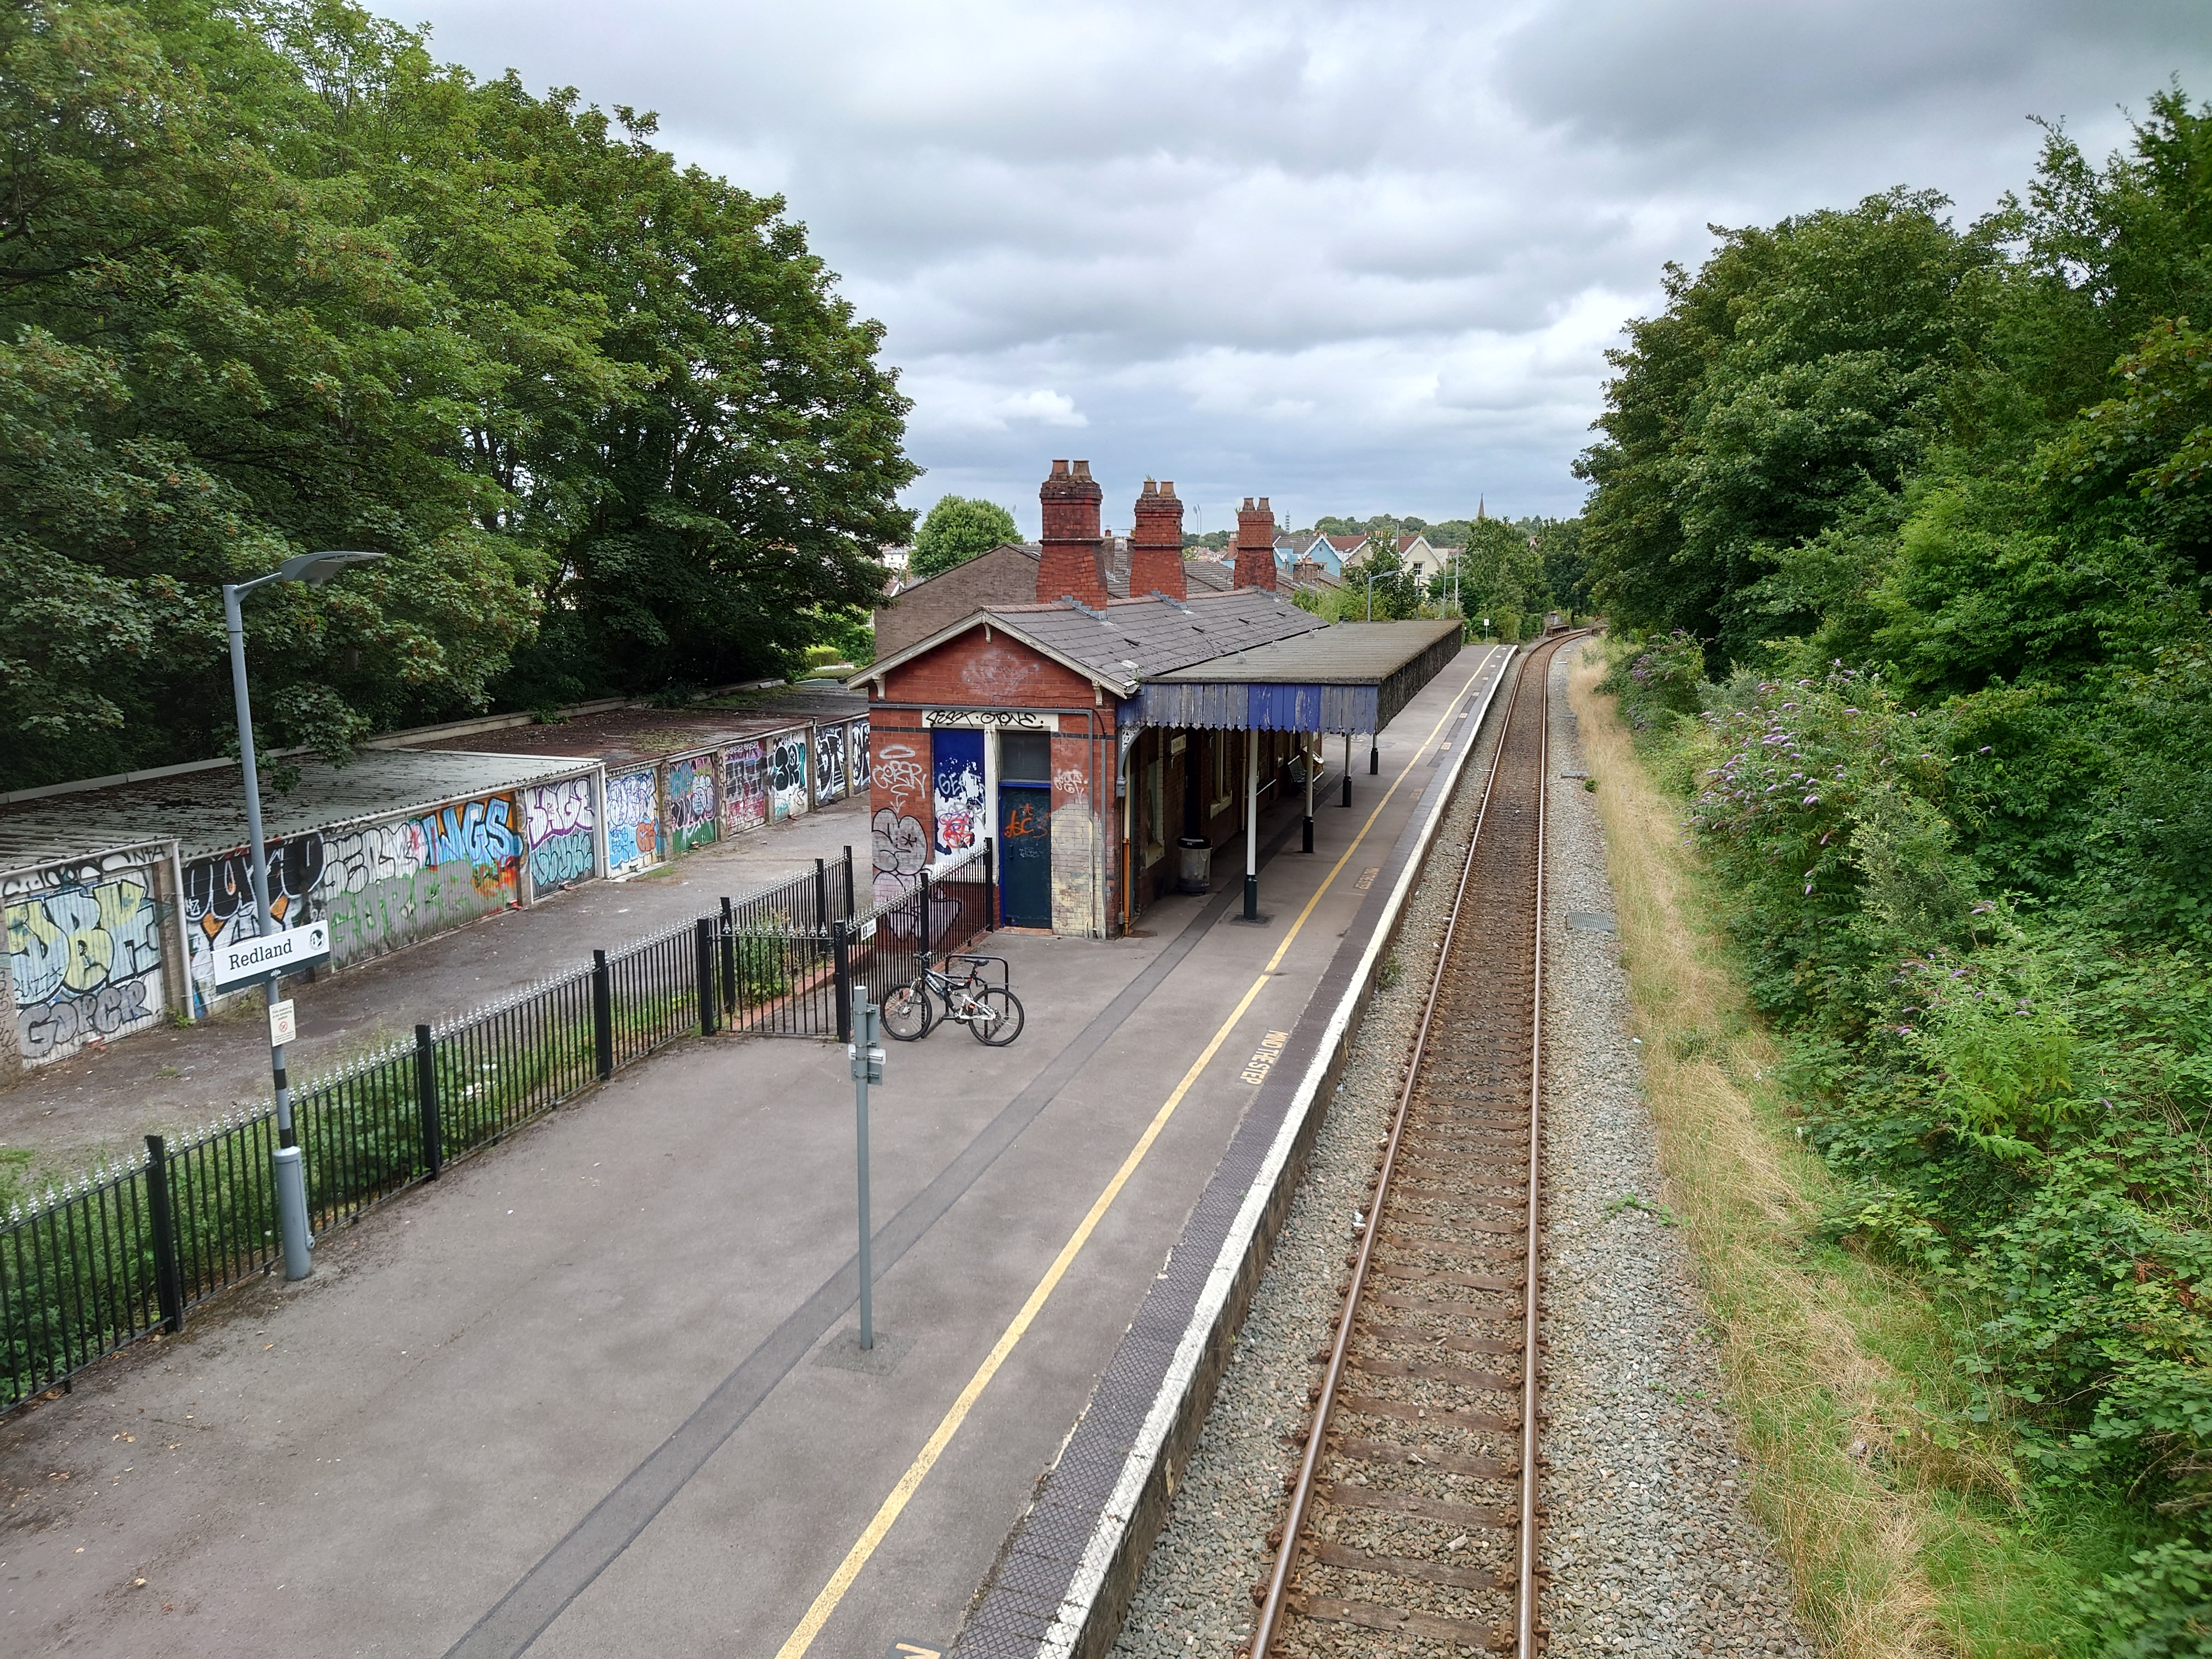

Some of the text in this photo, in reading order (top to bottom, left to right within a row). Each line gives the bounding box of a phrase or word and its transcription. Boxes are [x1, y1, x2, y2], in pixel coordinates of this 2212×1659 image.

[229, 938, 293, 970] Redland
[1240, 1030, 1289, 1085] MIND THE STEP
